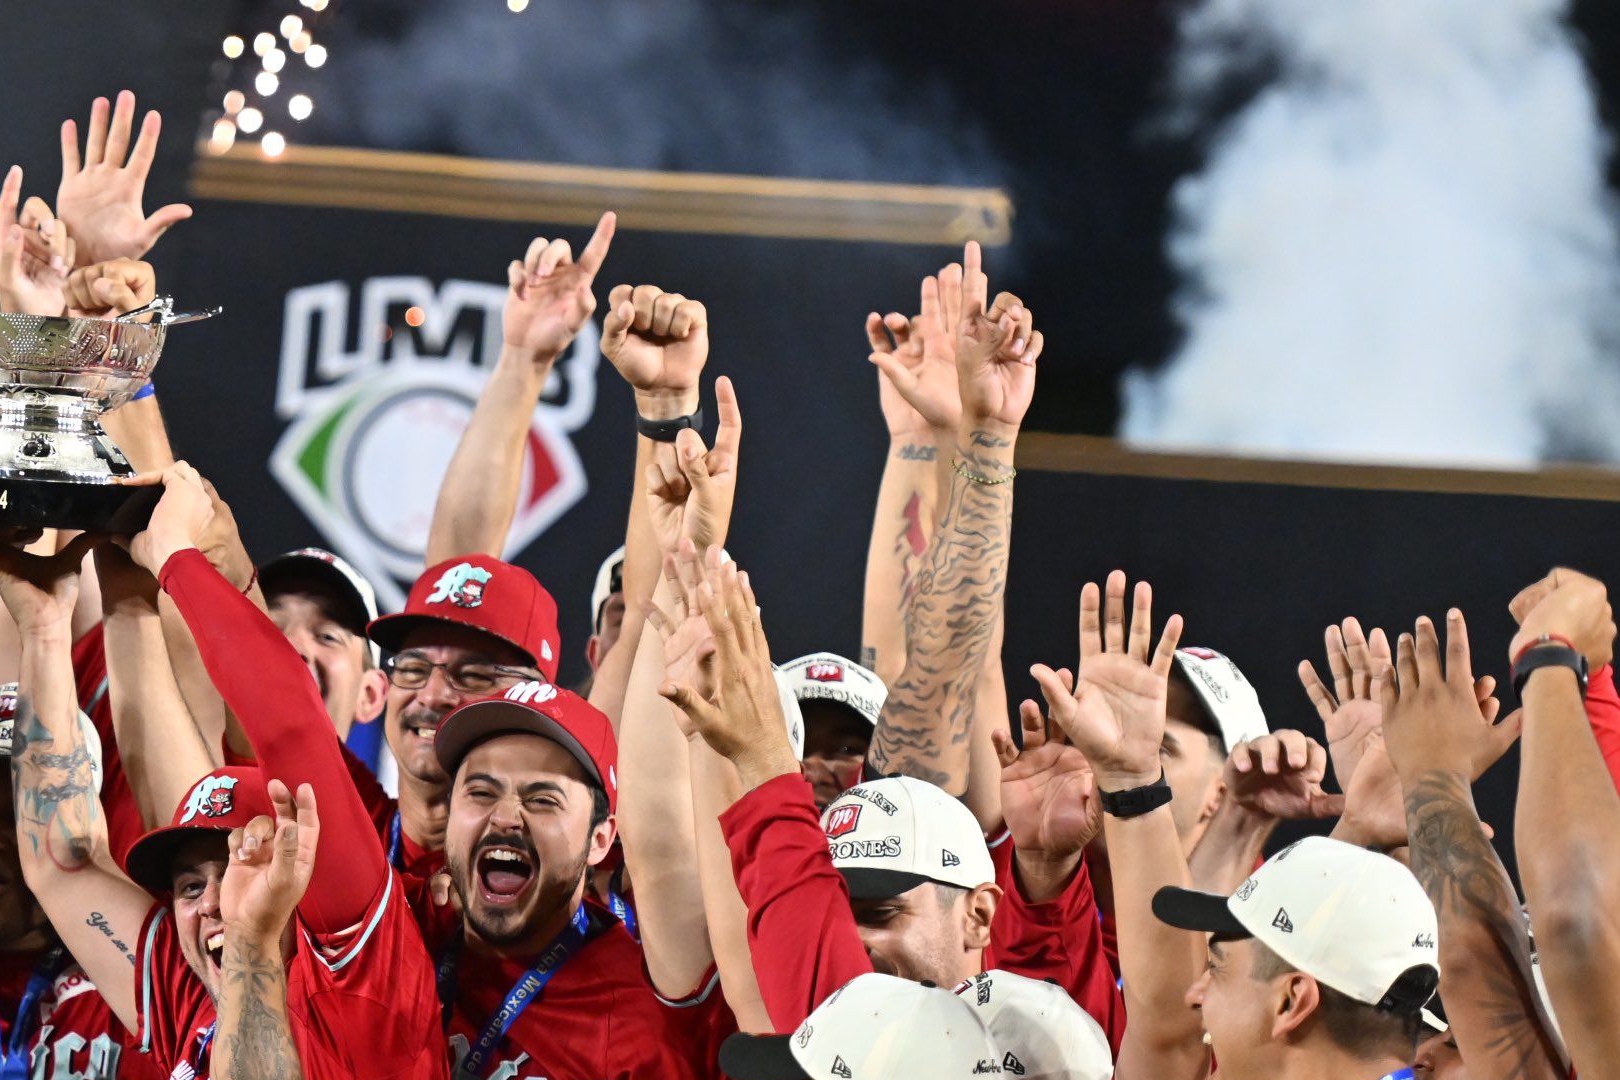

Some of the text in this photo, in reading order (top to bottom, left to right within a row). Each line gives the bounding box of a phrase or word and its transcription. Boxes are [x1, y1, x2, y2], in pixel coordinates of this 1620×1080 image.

[829, 836, 901, 860] EONES
[467, 943, 568, 1073] Liga Mexicana de
